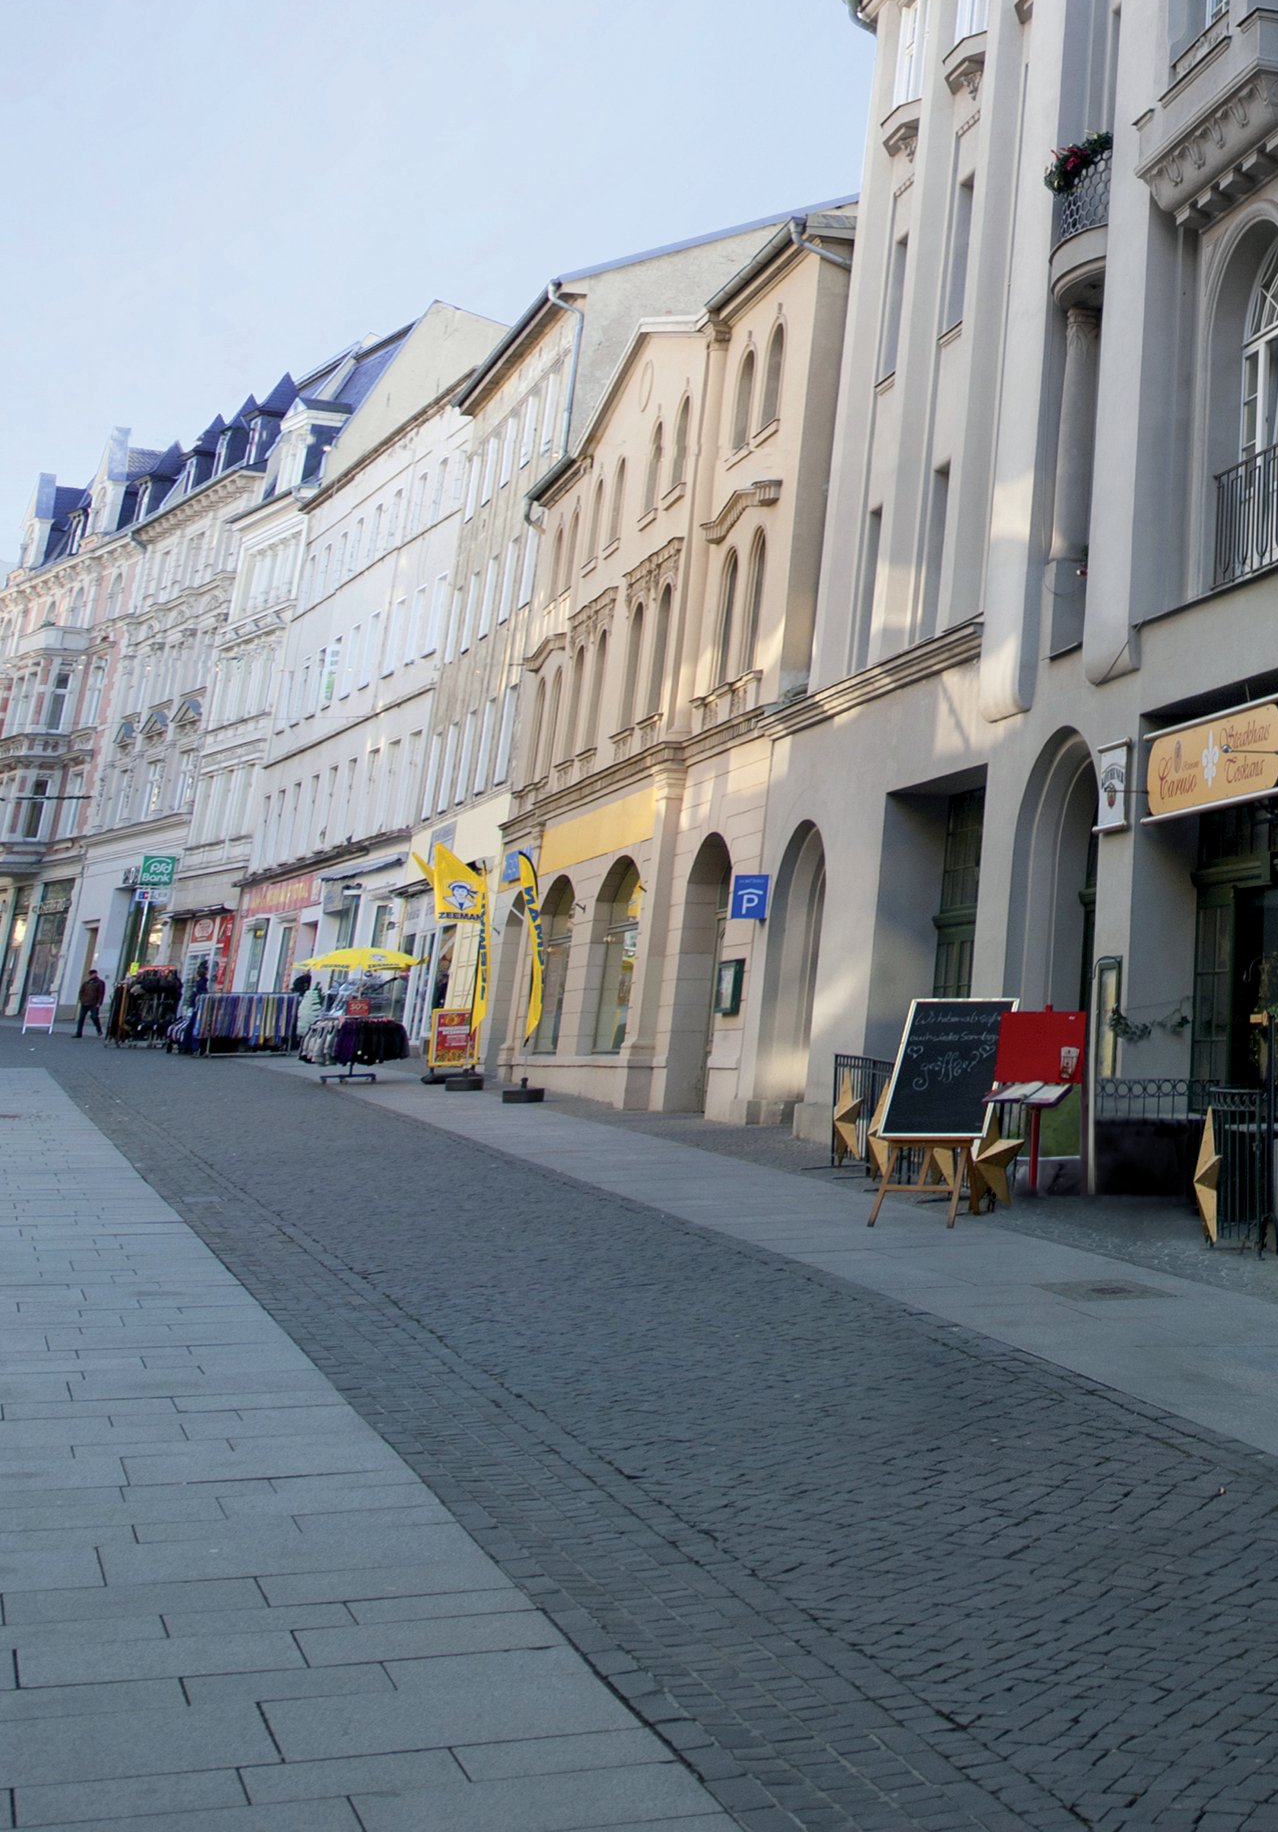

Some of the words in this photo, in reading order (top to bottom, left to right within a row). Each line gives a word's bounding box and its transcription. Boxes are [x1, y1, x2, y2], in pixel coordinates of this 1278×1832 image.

[1224, 758, 1266, 784] Toskana
[142, 872, 170, 883] Bank
[742, 894, 759, 915] P
[438, 912, 484, 921] ZEEMAN
